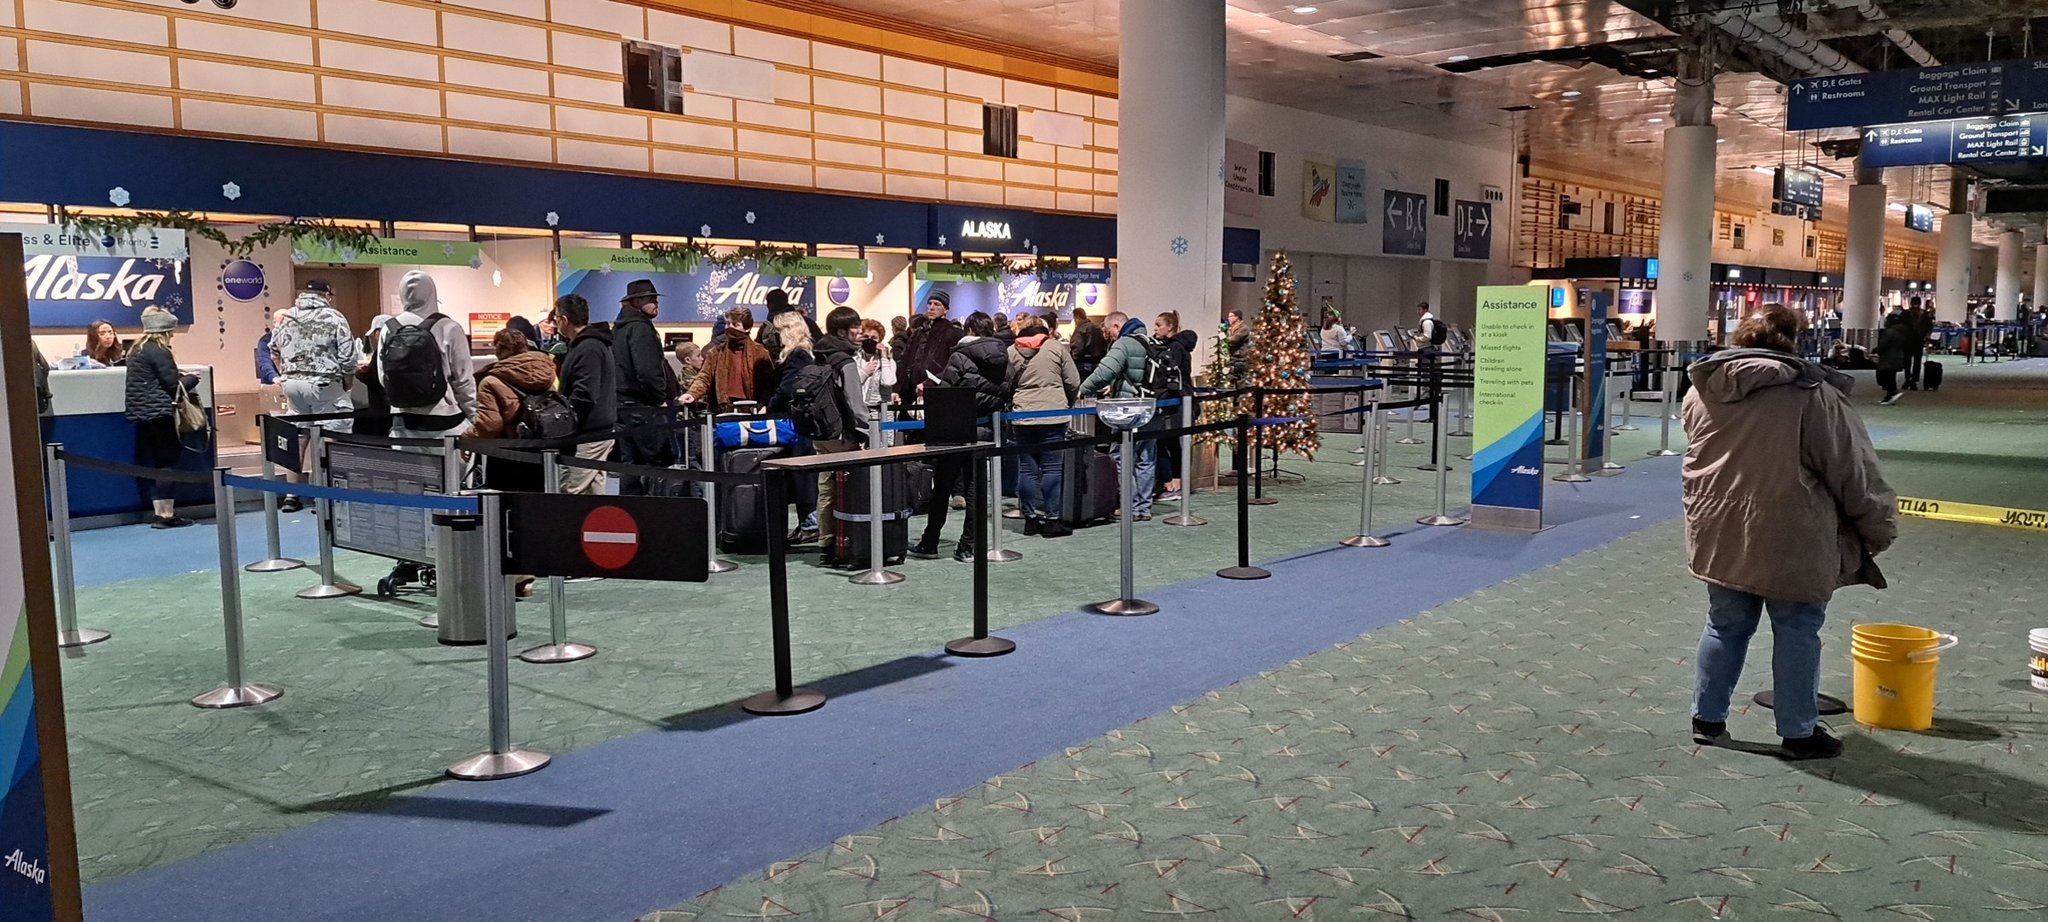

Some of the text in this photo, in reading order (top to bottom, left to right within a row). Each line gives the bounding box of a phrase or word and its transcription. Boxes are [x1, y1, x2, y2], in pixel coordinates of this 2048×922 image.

[1920, 66, 1987, 80] Baggage Claim
[1822, 78, 1862, 88] D,E Gates
[1910, 80, 1986, 93] Ground Transport
[1822, 90, 1865, 100] Restrooms
[1918, 91, 1986, 104] MAX Light Rail
[1908, 105, 1984, 117] Rental Car Center
[1959, 130, 2018, 140] Ground Transport
[1986, 140, 2003, 148] Light
[1232, 173, 1247, 183] Under
[1225, 180, 1254, 193] Construction
[1406, 198, 1424, 238] B,C
[1458, 205, 1473, 242] D,E
[962, 220, 1012, 239] ALASKA
[43, 234, 53, 245] &
[59, 234, 90, 246] Elite
[118, 238, 148, 247] Priority
[360, 245, 418, 256] Assistance
[798, 262, 832, 271] Assistance
[24, 255, 164, 307] Alaska
[225, 276, 262, 284] oneworld
[1011, 281, 1070, 310] Alaska
[1482, 300, 1537, 310] Assistance
[278, 435, 288, 452] EXIT
[1510, 465, 1540, 476] Alaska
[4, 849, 45, 885] Alaska
